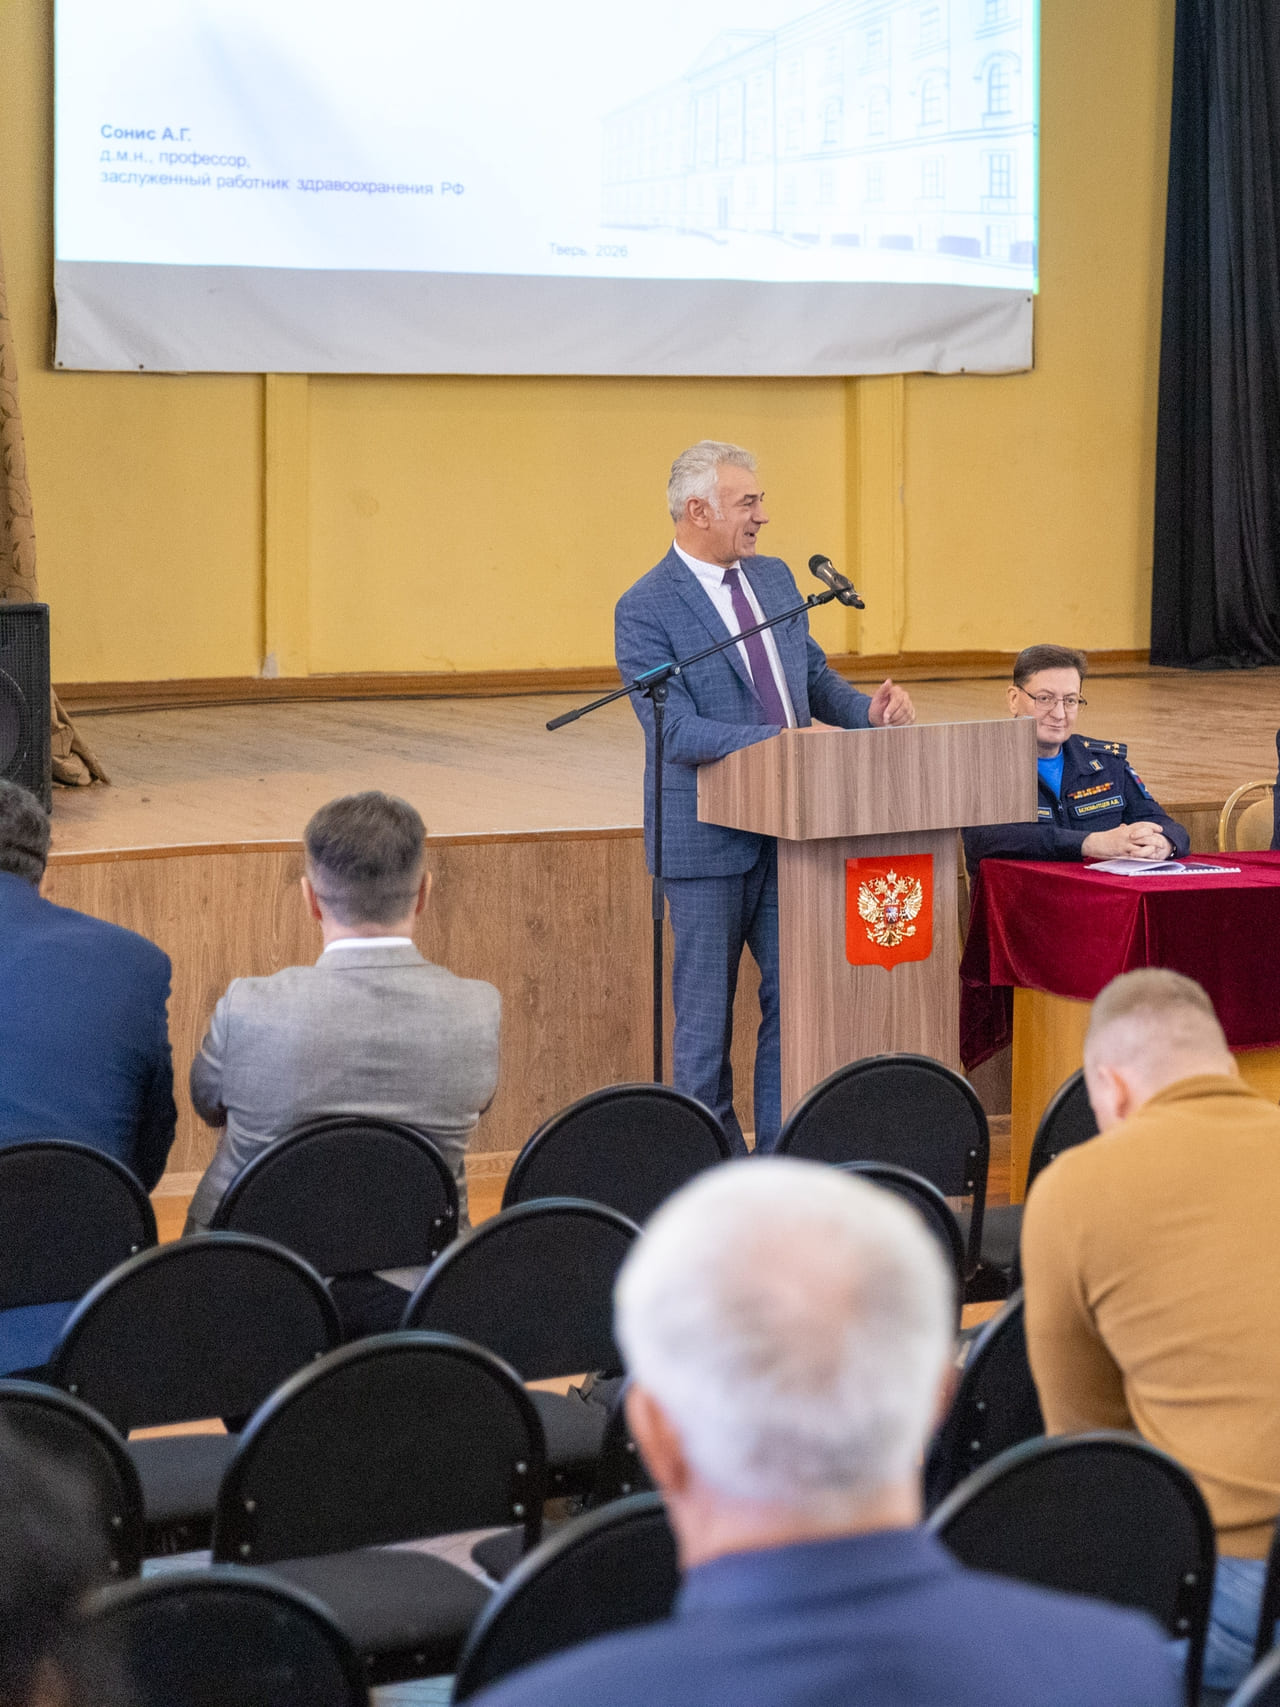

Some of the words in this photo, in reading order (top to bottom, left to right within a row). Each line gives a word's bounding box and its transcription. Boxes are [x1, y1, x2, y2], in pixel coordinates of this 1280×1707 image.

[100, 124, 156, 140] Сонис
[161, 127, 192, 142] А.Г.
[159, 151, 251, 169] профессор,
[100, 171, 211, 188] заслуженный
[216, 174, 290, 191] работник
[297, 178, 434, 195] здравоохранения
[441, 181, 465, 196] РФ
[595, 244, 629, 257] 2026
